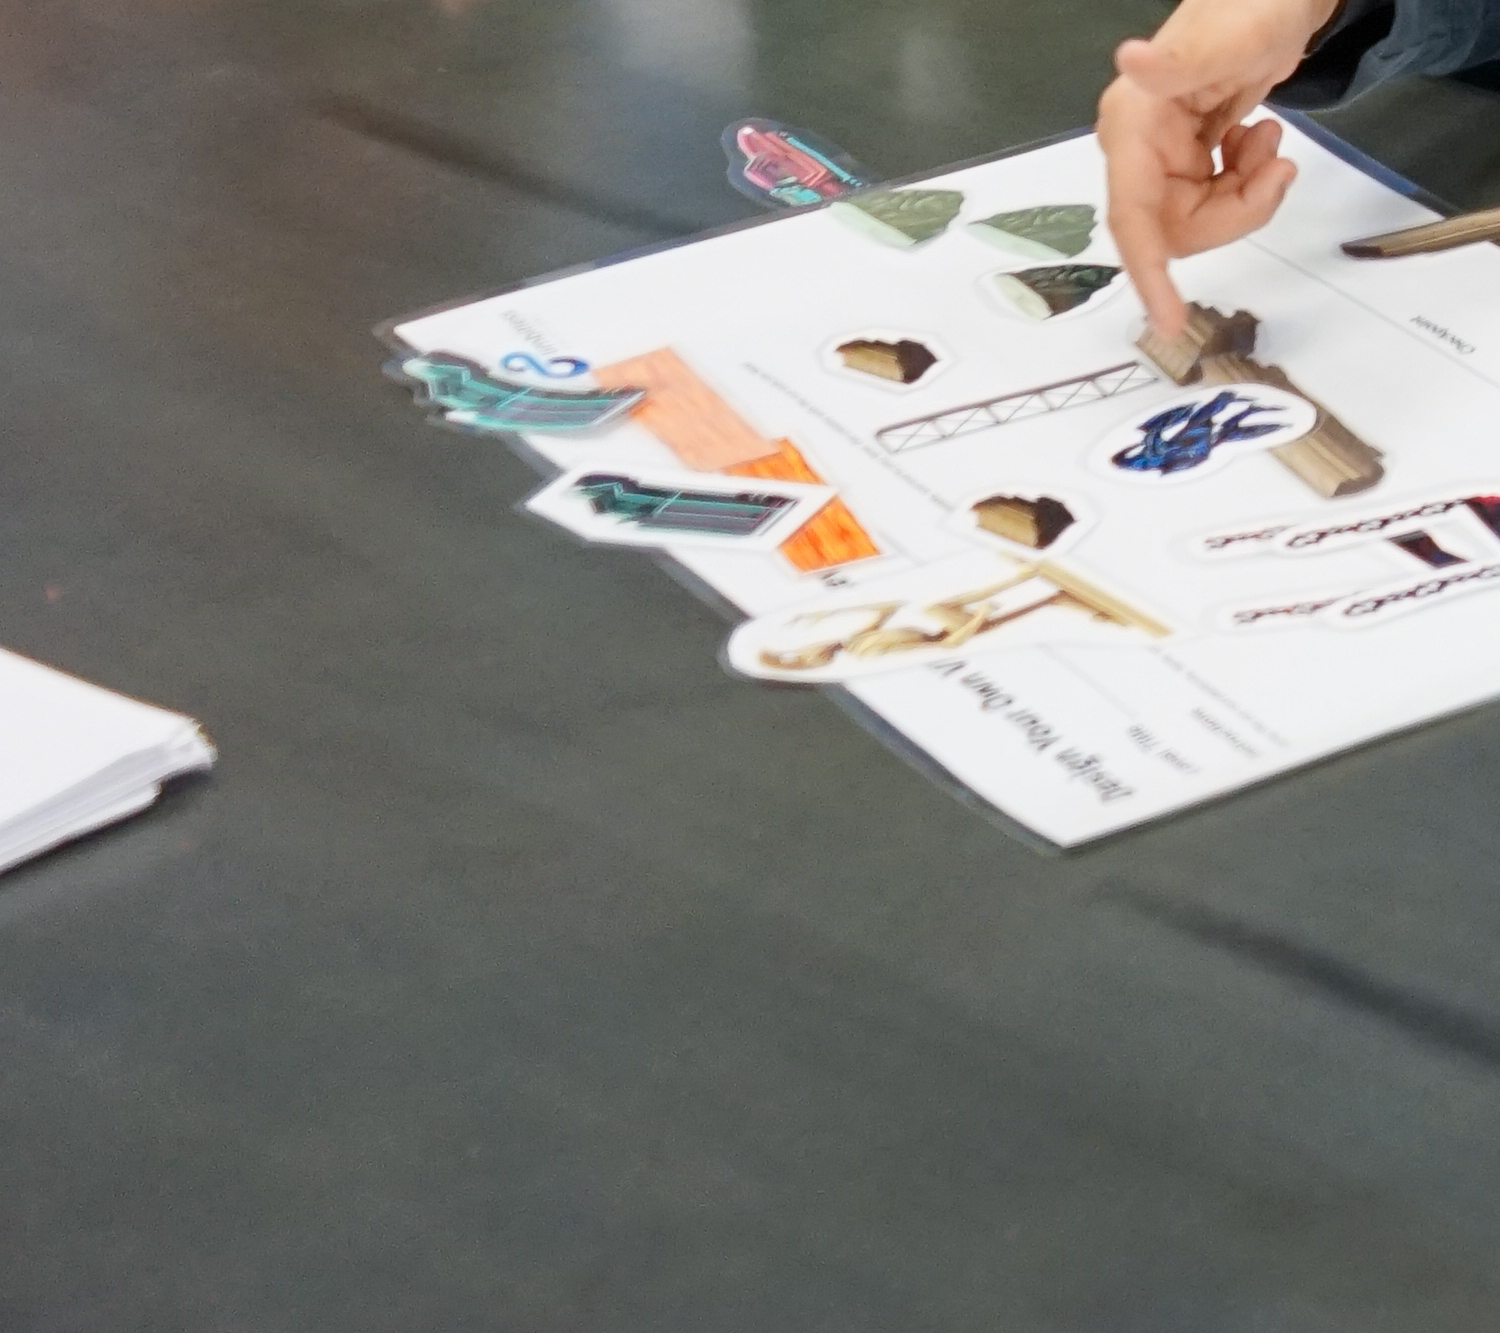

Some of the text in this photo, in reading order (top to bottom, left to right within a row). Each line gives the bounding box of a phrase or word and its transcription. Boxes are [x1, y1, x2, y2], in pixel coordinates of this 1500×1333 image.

[962, 671, 1137, 805] Design Your Own
